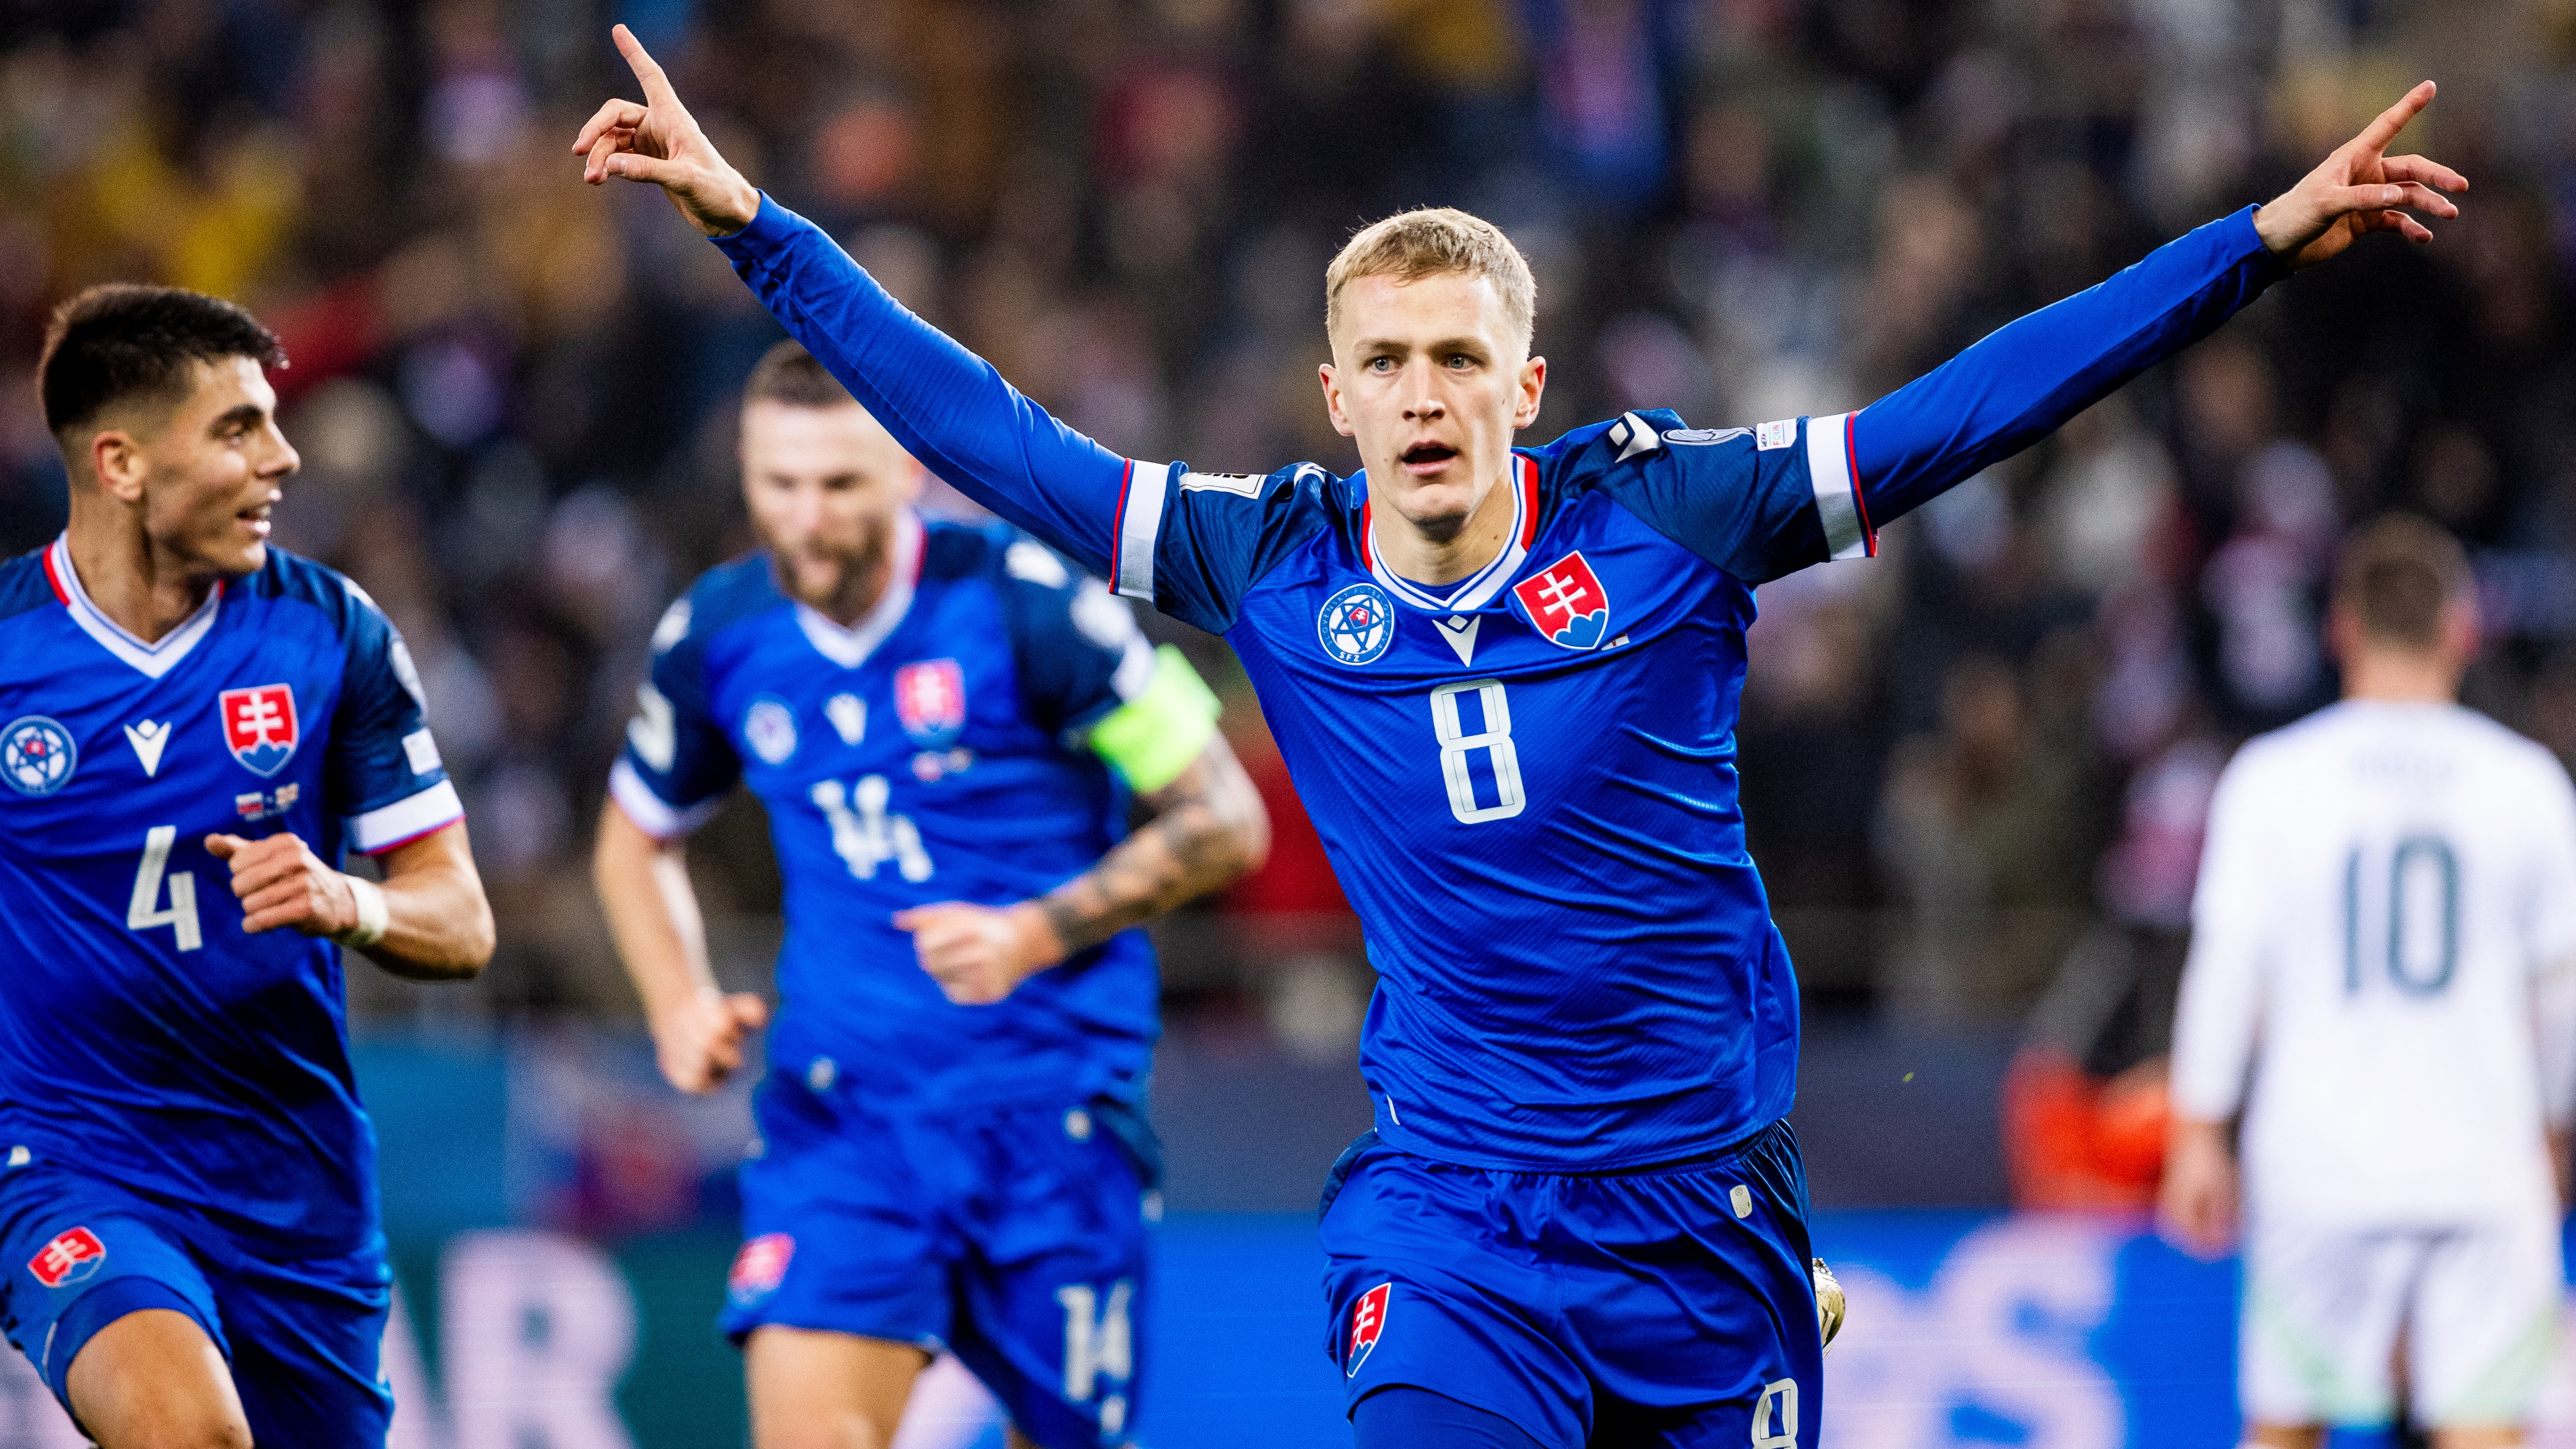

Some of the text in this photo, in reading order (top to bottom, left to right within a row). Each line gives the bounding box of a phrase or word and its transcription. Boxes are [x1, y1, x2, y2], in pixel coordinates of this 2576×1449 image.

[1339, 651, 1360, 662] SFZ
[1430, 678, 1526, 824] 8
[127, 825, 202, 951] 4
[811, 775, 934, 883] 14
[2342, 833, 2461, 997] 10
